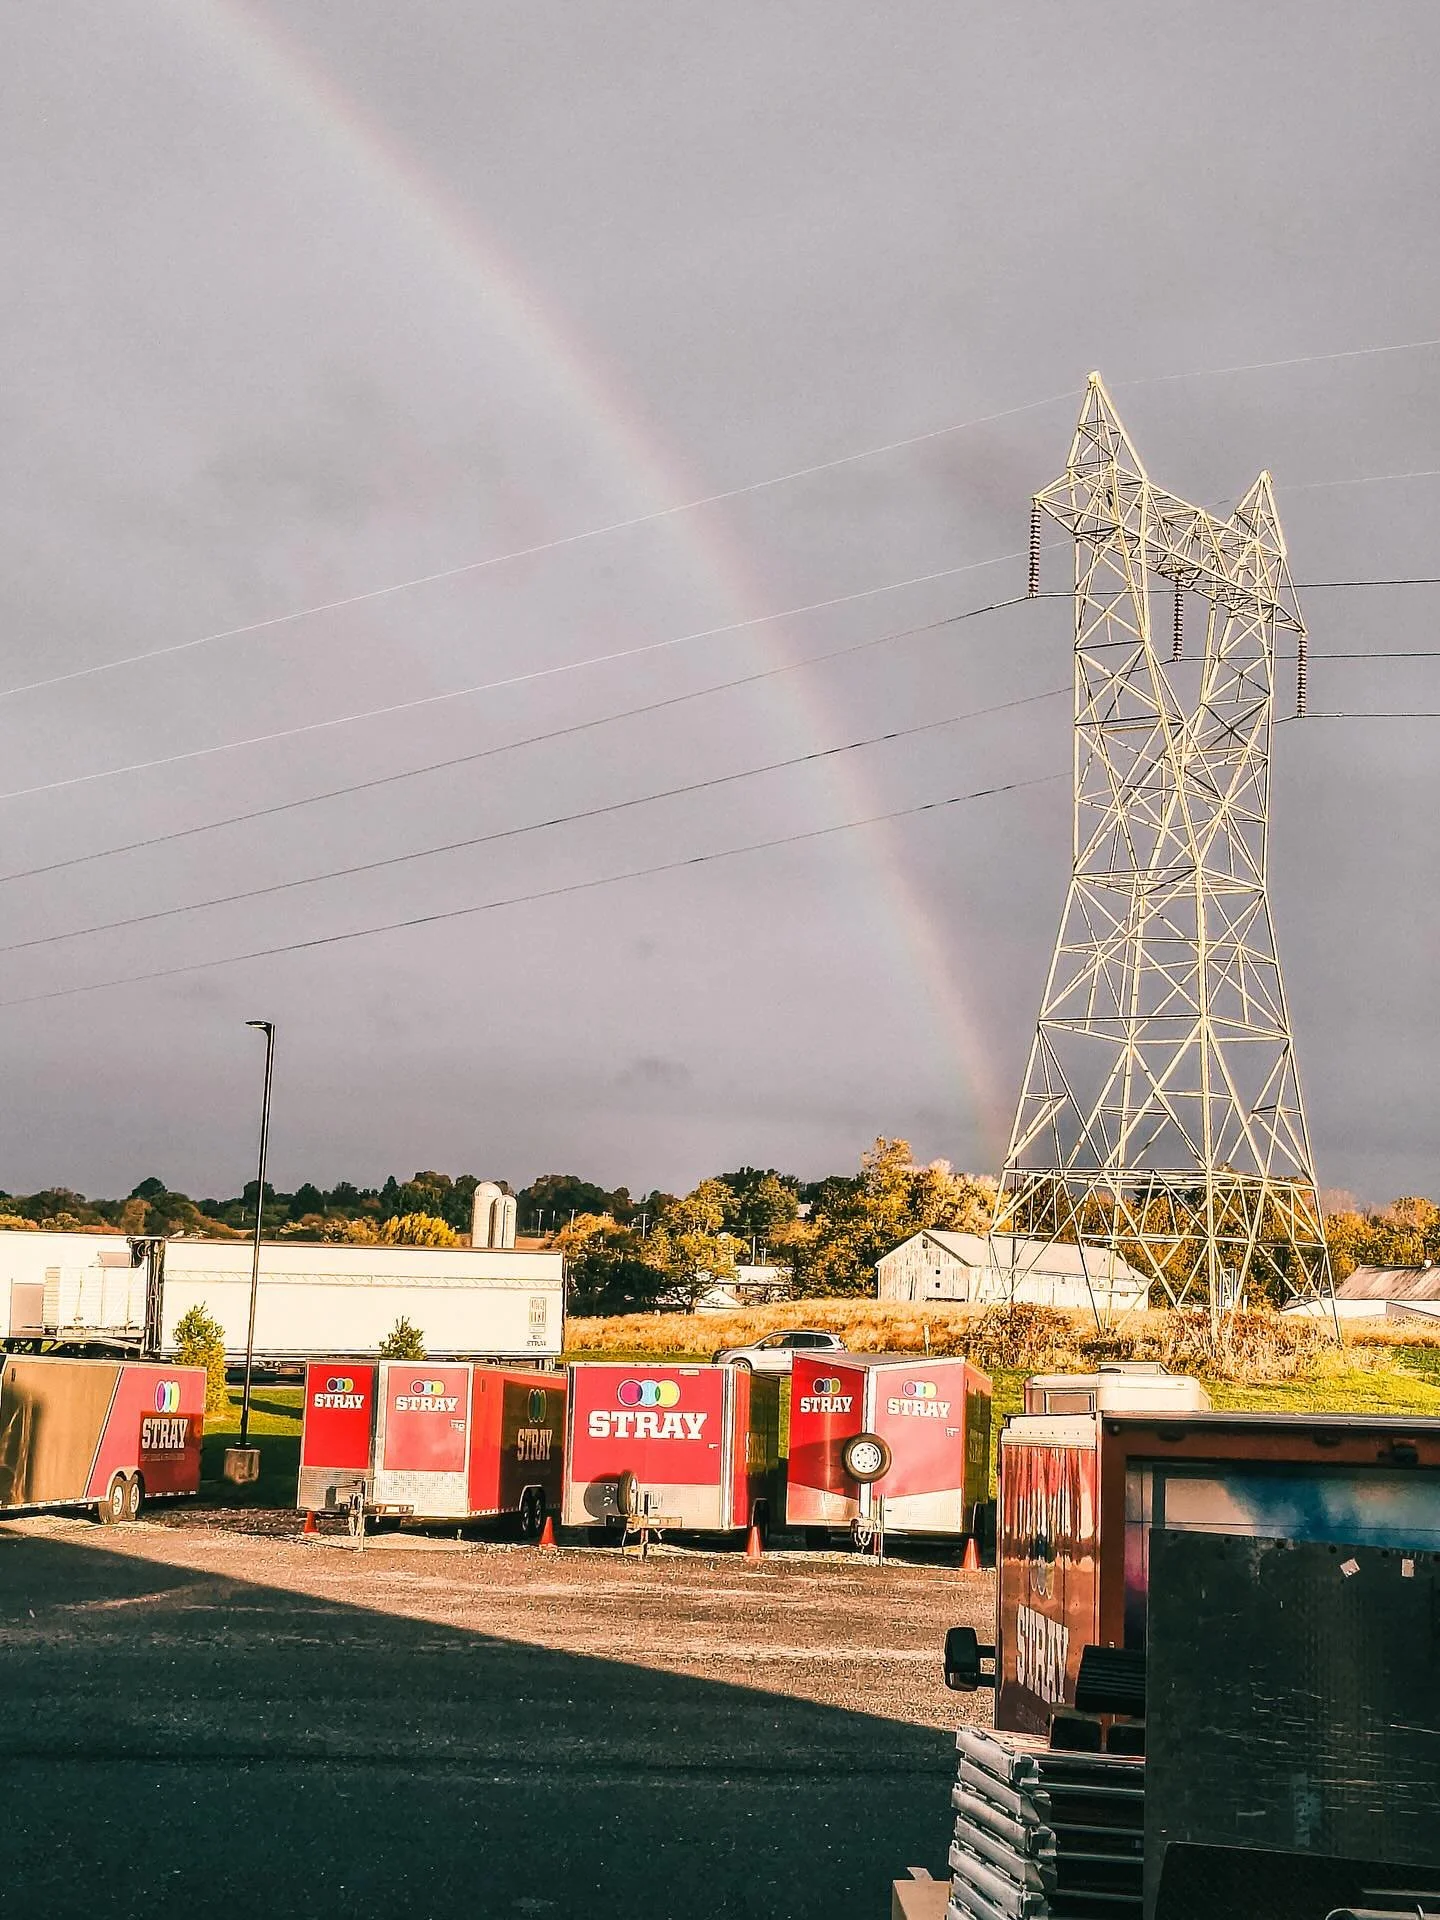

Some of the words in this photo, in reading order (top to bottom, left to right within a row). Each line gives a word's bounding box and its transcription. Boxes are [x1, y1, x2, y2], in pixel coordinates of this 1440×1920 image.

[313, 1393, 365, 1409] STRAY
[395, 1396, 459, 1412] STRAY
[800, 1396, 853, 1413] STRAY
[887, 1397, 952, 1419] STRAY
[141, 1417, 189, 1449] STRAY
[587, 1410, 708, 1440] STRAY
[517, 1428, 553, 1461] STRAY
[1016, 1603, 1069, 1704] STRAY
